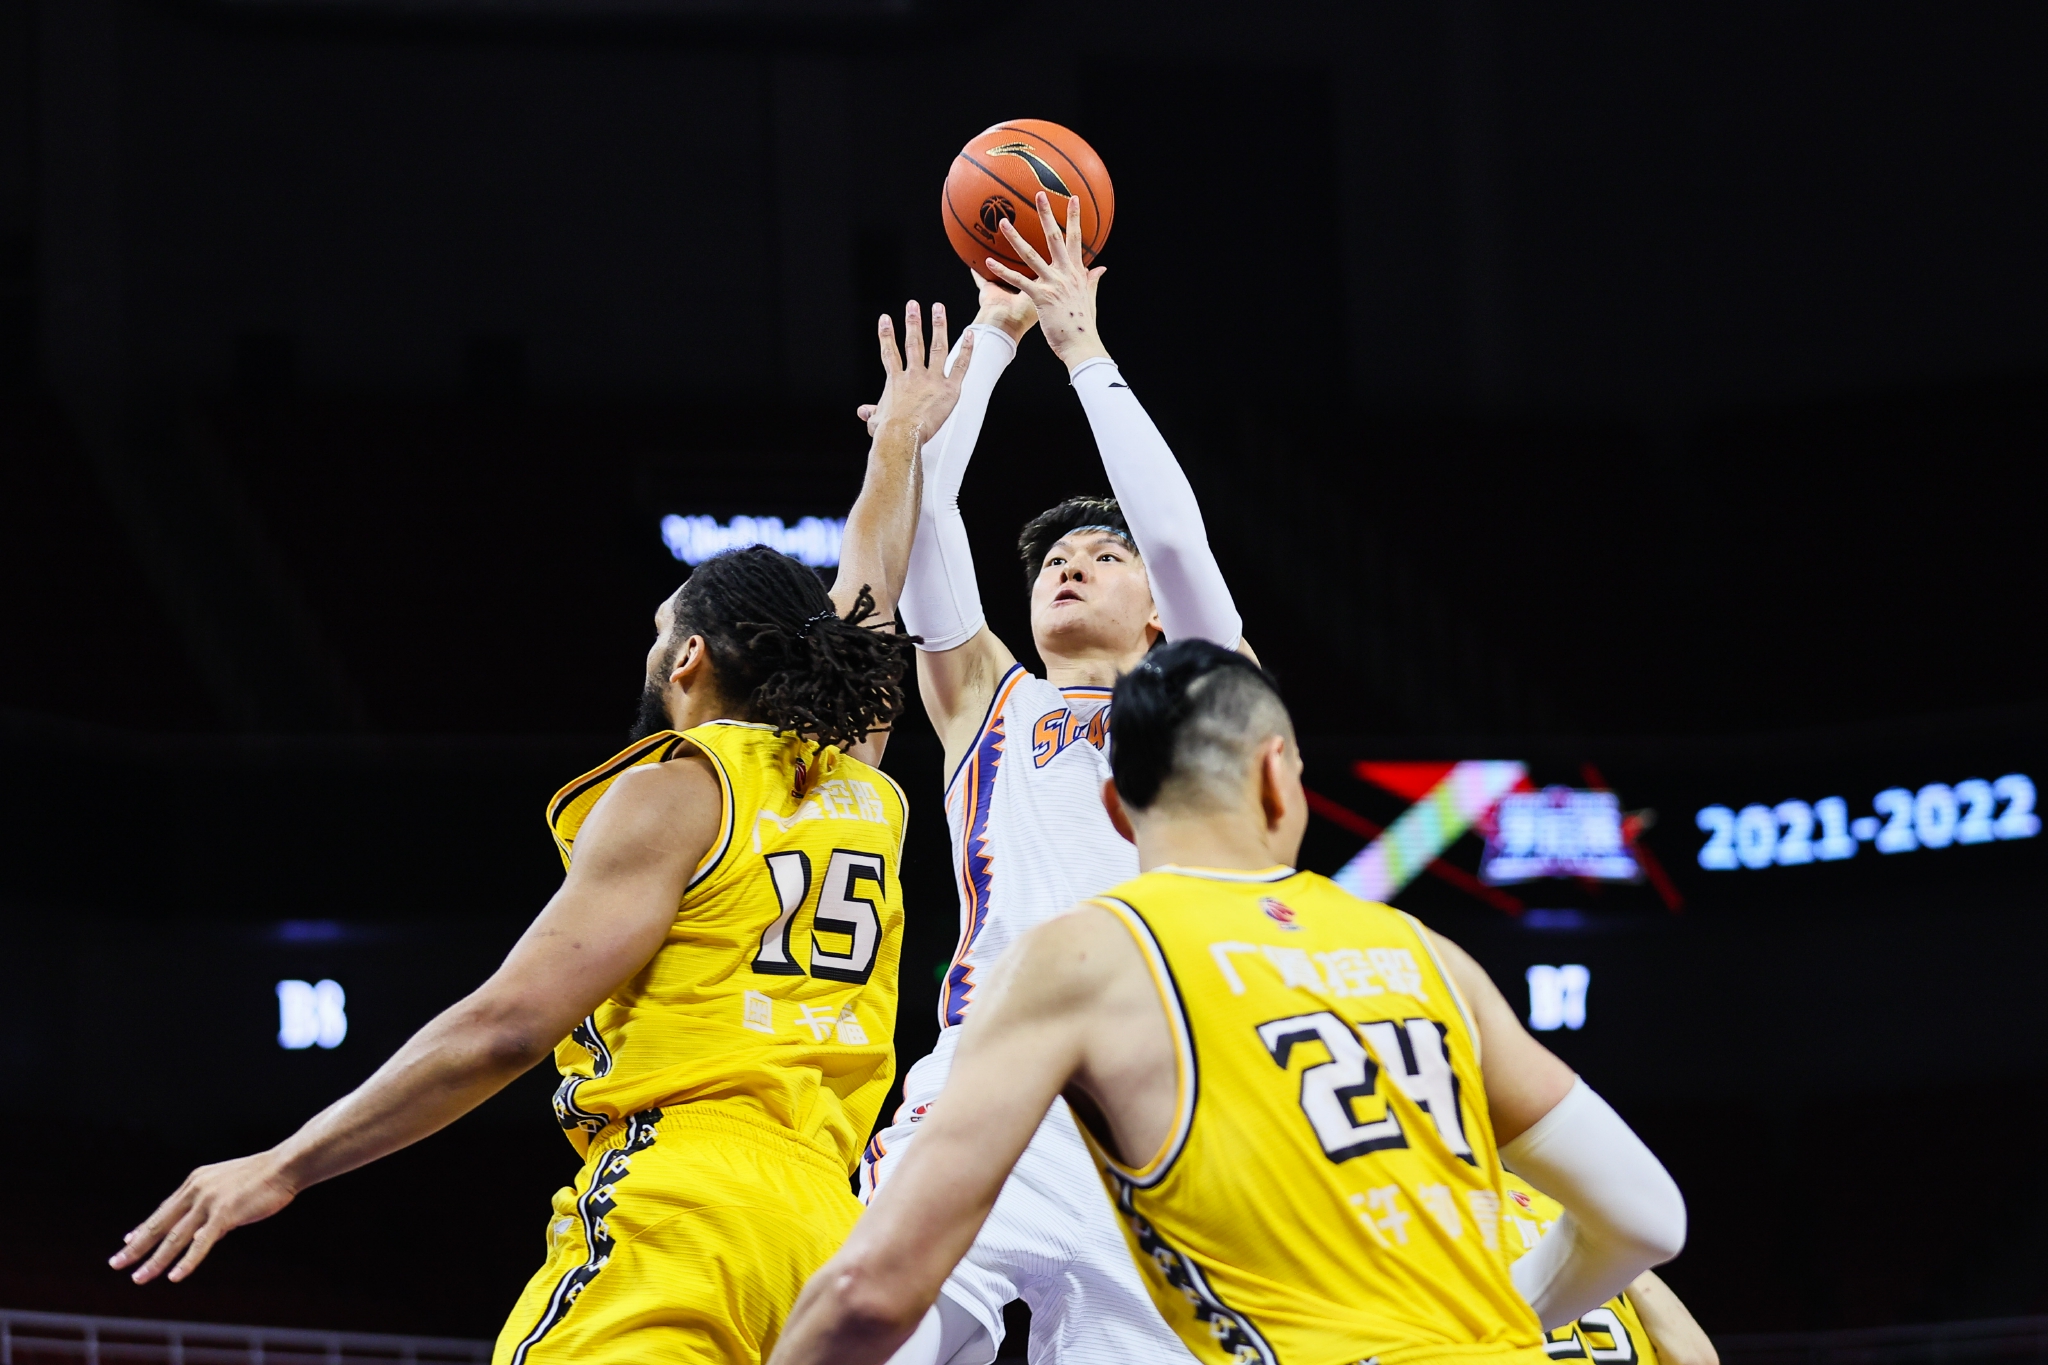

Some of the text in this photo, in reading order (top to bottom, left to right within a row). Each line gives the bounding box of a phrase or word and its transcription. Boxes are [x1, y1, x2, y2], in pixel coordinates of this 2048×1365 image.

[1697, 773, 2041, 870] 2021-2022
[751, 848, 886, 985] 15
[1256, 1011, 1481, 1164] 24
